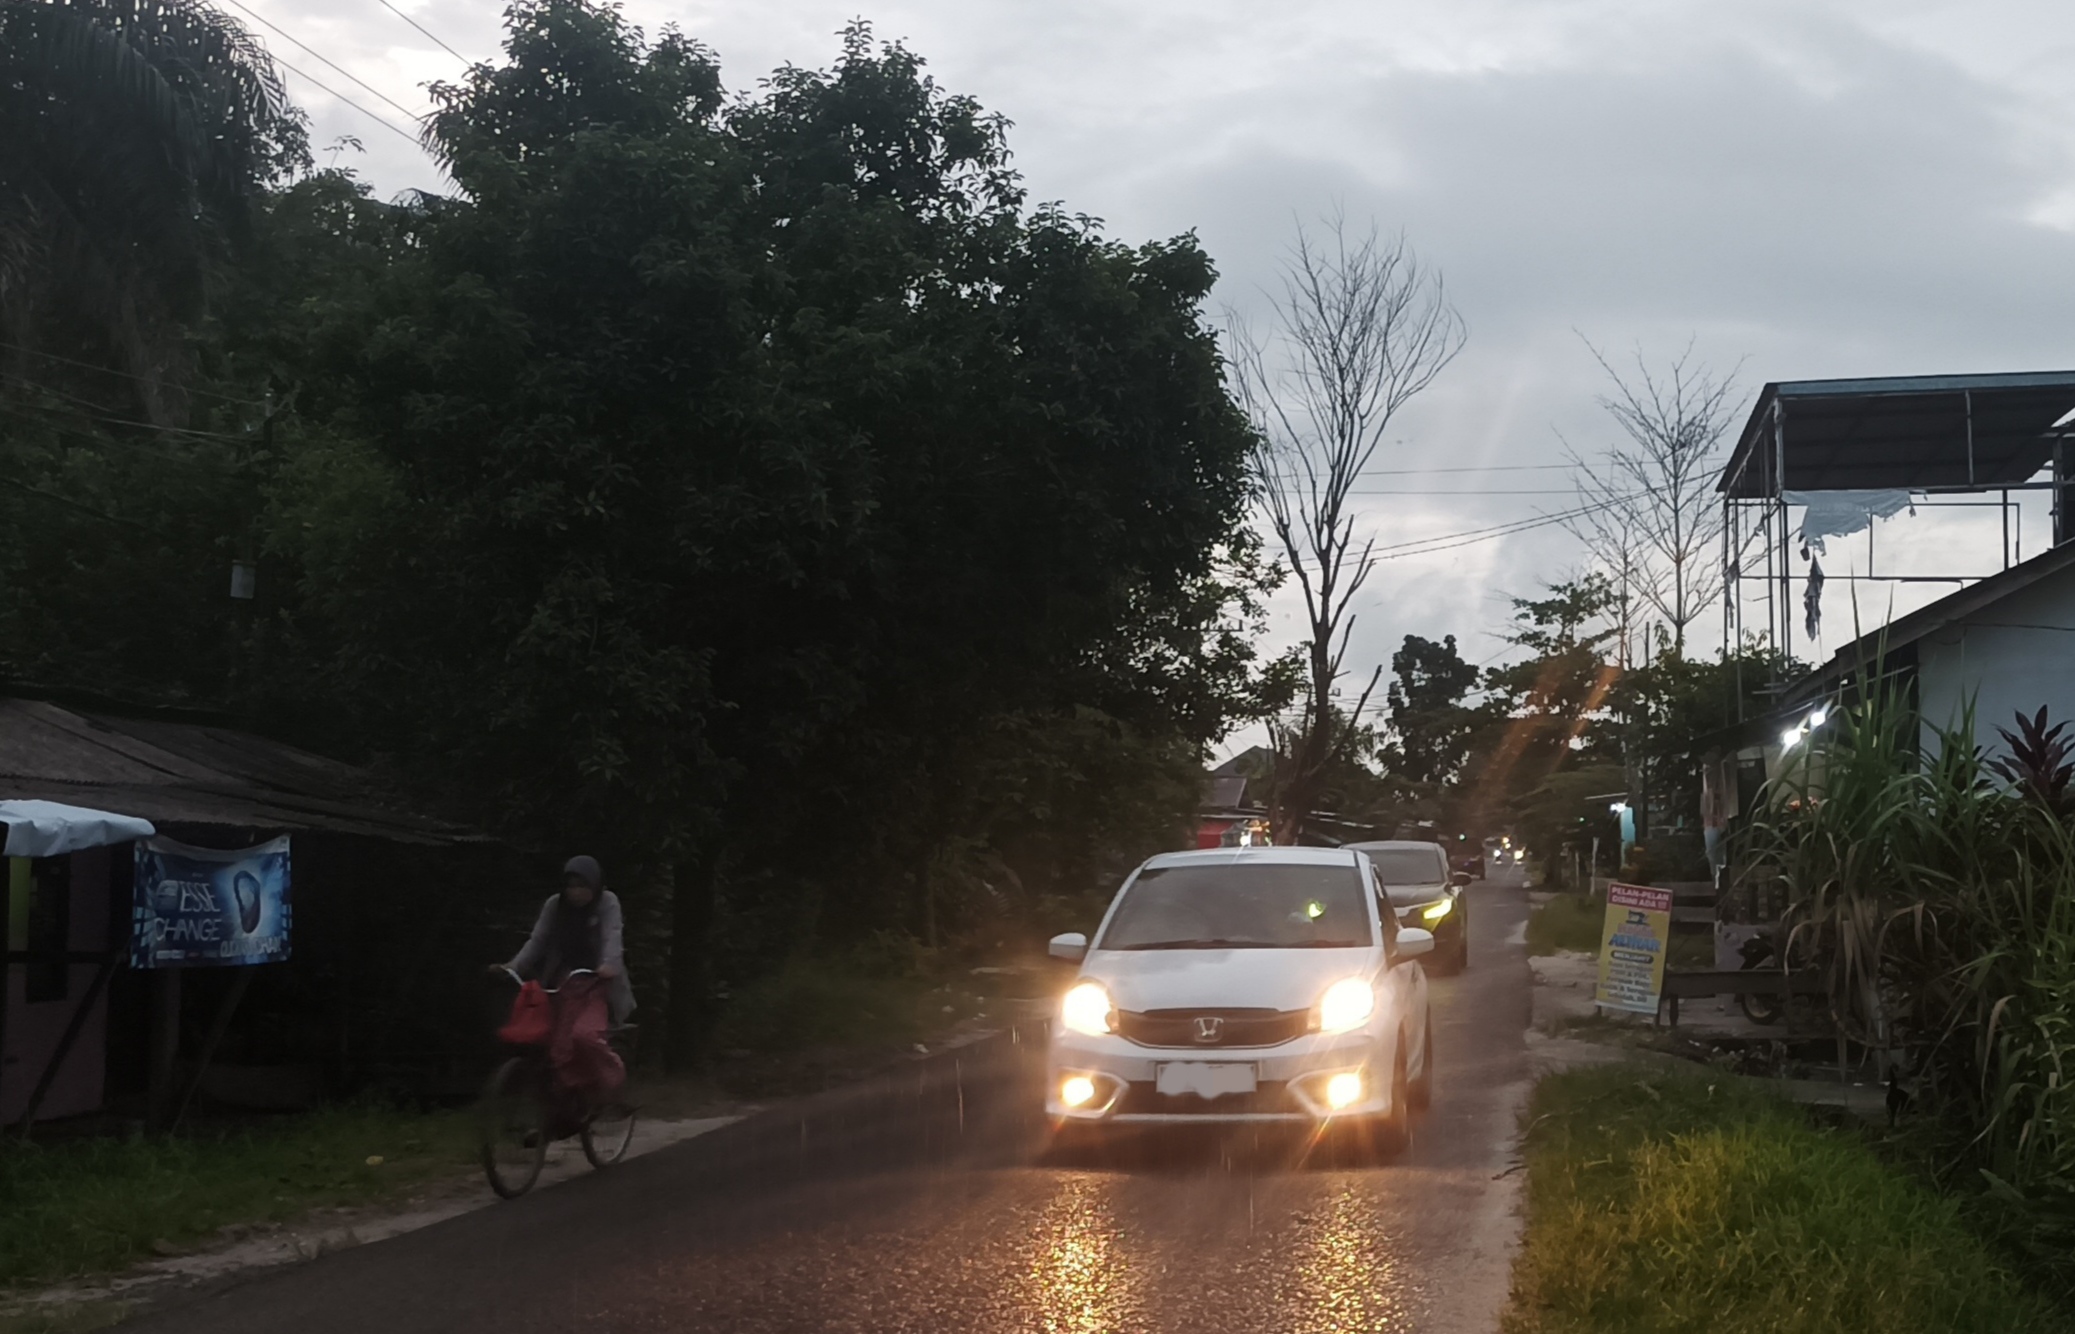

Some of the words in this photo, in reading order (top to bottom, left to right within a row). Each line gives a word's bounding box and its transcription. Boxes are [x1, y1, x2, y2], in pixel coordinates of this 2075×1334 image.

[179, 880, 221, 912] ESSE
[1611, 886, 1669, 901] PELAN-PELAN
[1611, 895, 1638, 905] DISINI
[1638, 899, 1657, 908] ADA
[154, 917, 222, 941] CHANGE
